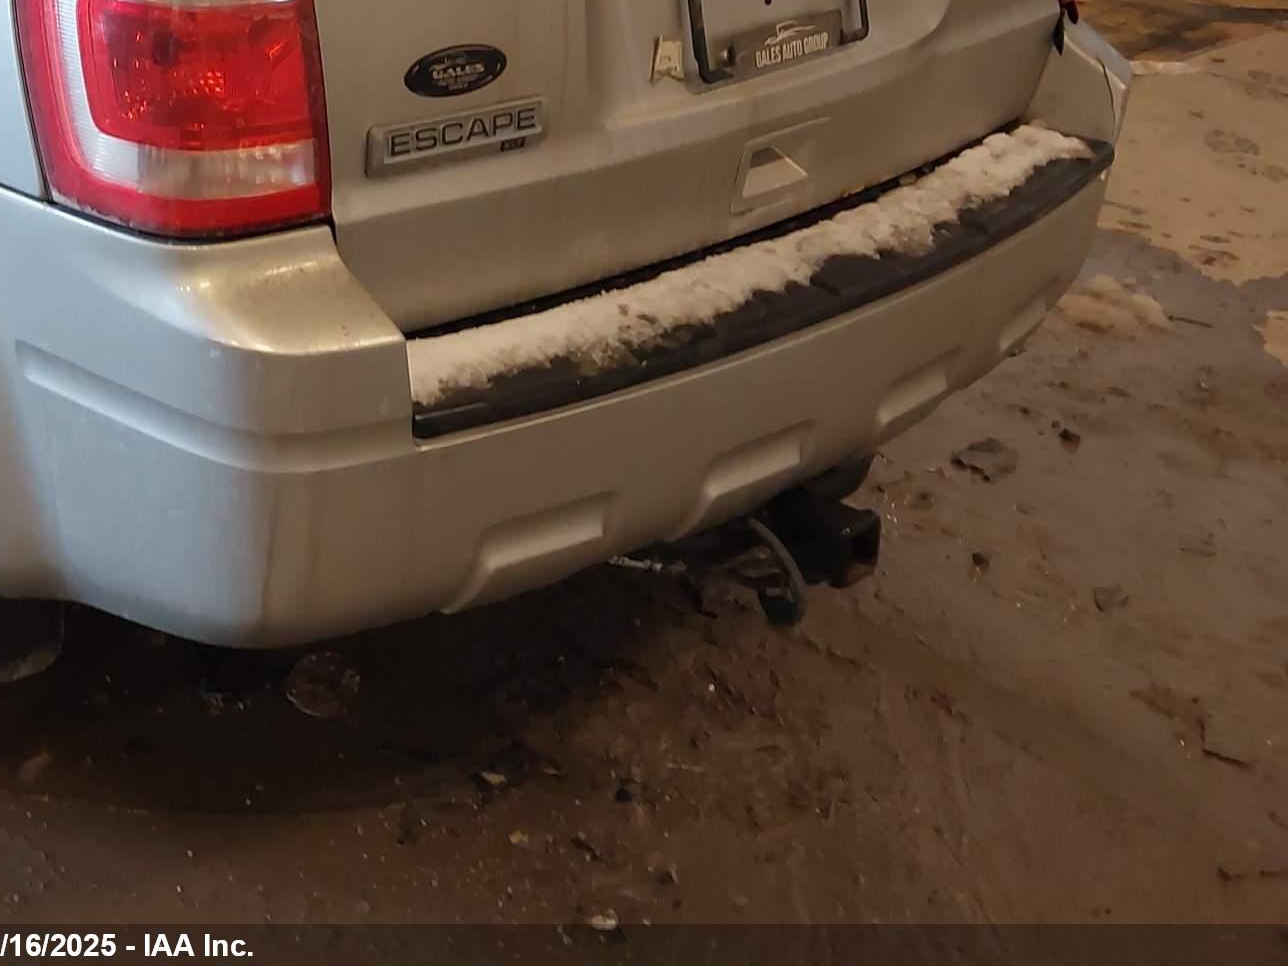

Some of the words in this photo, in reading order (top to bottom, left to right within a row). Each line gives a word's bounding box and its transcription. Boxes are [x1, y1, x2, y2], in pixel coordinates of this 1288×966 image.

[782, 39, 804, 62] AUTO
[803, 31, 829, 55] GROUP
[390, 106, 537, 157] ESCAPE
